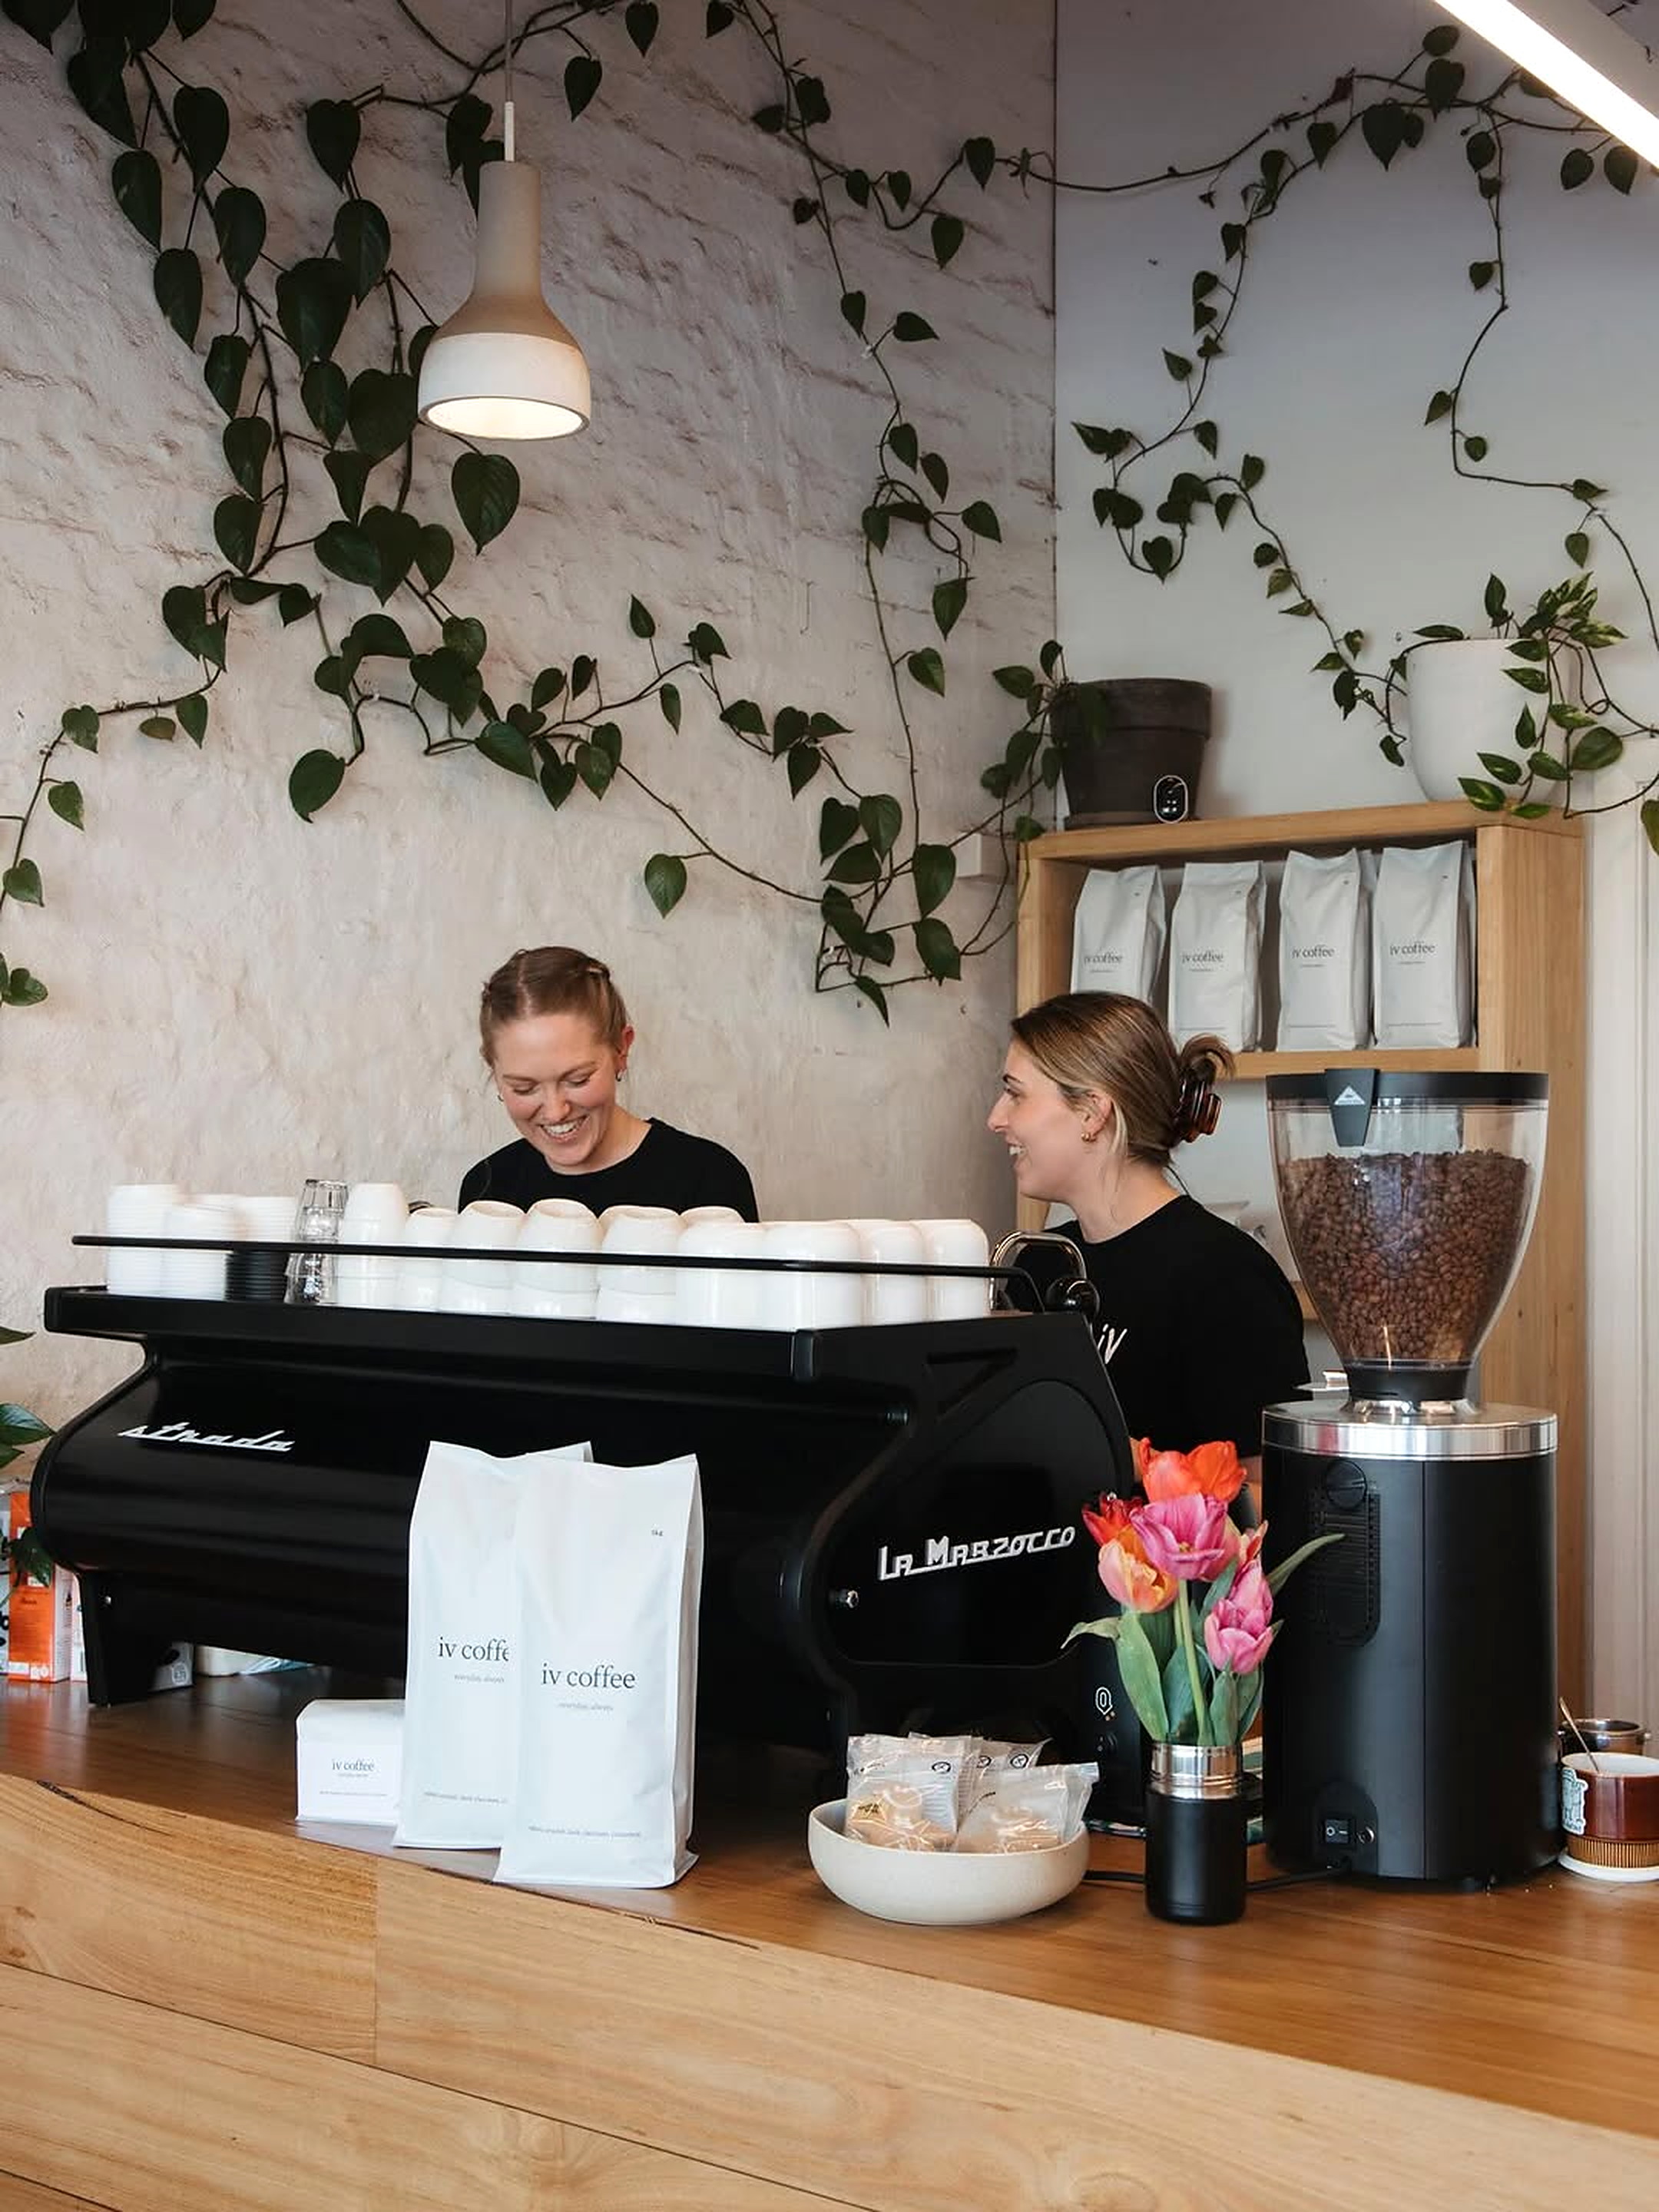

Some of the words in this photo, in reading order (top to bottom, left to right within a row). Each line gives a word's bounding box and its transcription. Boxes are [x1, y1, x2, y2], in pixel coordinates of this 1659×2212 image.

[1303, 944, 1335, 958] coffee
[1402, 940, 1435, 955] coffee
[1093, 950, 1123, 963] coffee
[1192, 949, 1224, 962] coffee
[117, 1422, 295, 1452] strada
[438, 1636, 457, 1658] iv
[541, 1662, 561, 1685] iv
[566, 1664, 636, 1689] coffee
[343, 1758, 375, 1772] coffee
